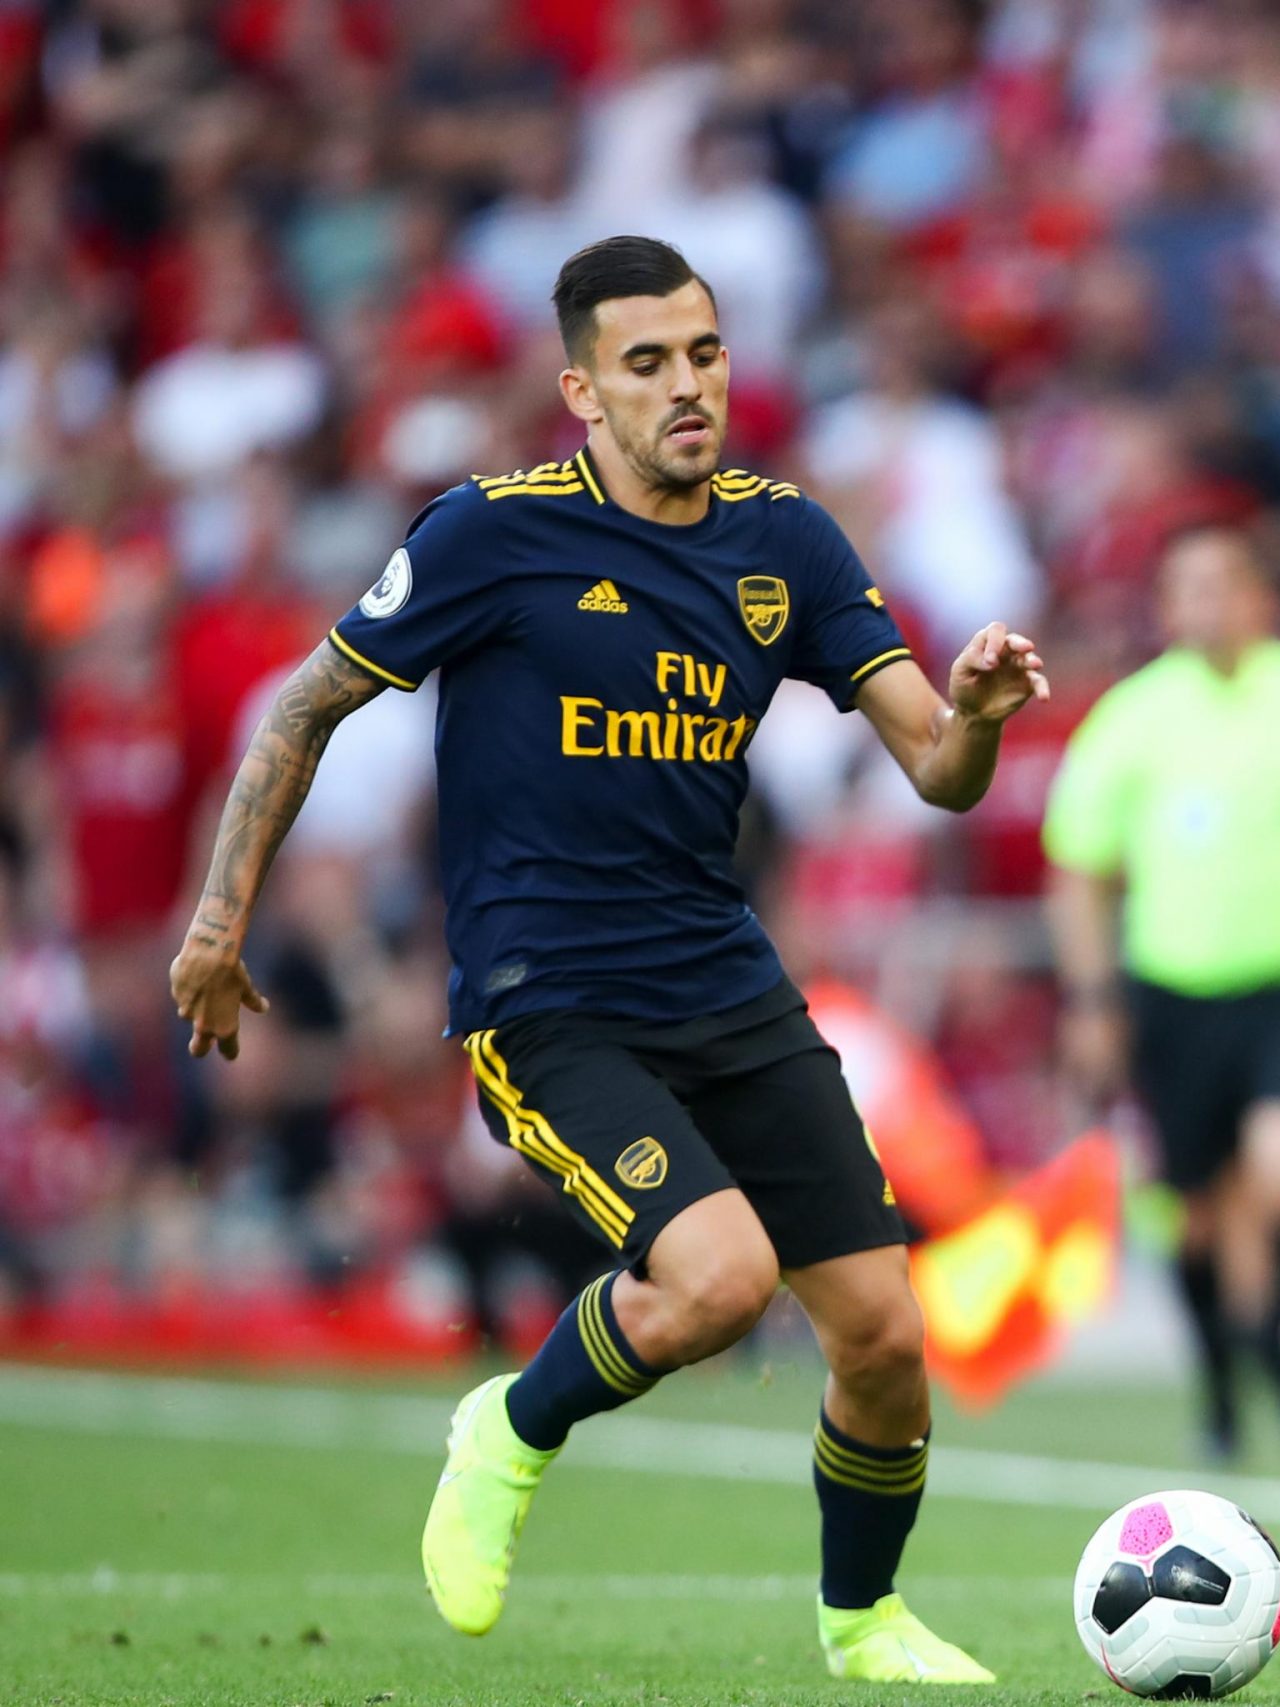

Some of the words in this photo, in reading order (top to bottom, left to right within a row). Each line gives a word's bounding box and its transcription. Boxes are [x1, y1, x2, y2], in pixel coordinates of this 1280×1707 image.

[577, 598, 629, 614] adidas
[656, 651, 727, 707] Fly
[559, 695, 754, 762] Emirat
